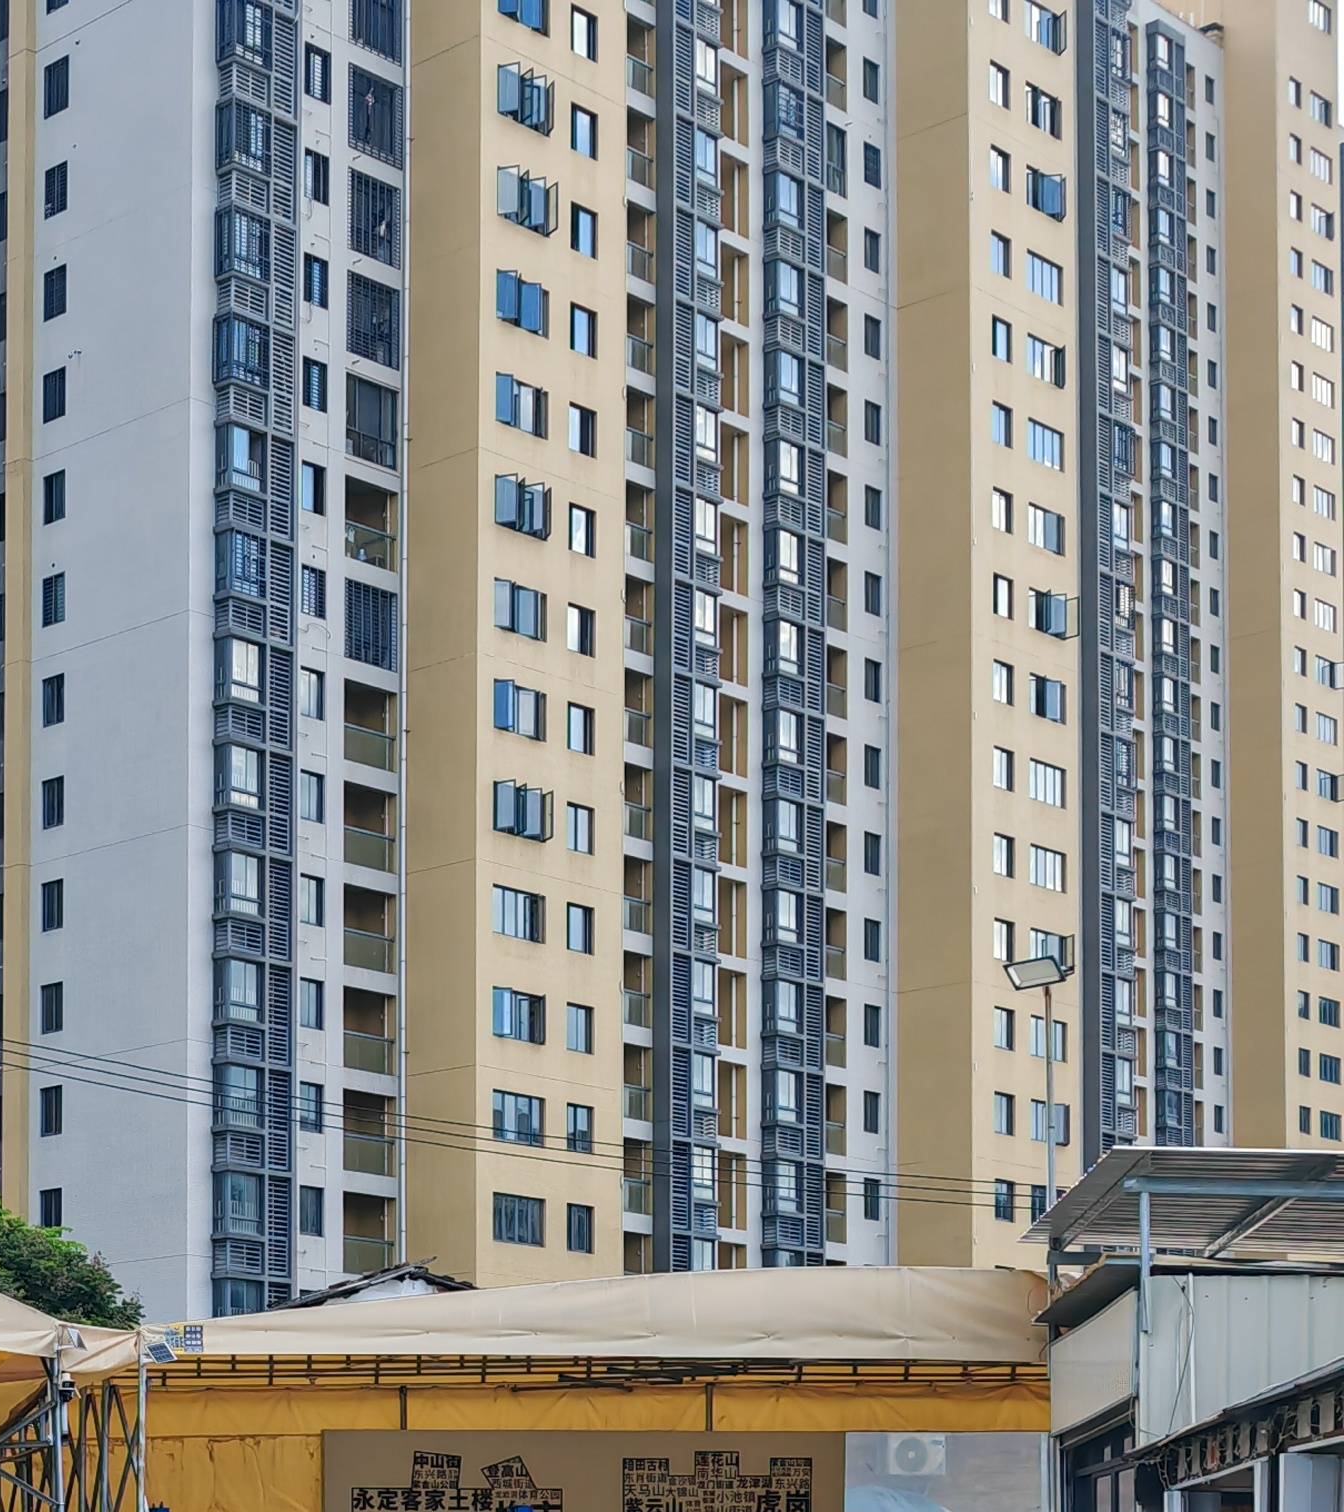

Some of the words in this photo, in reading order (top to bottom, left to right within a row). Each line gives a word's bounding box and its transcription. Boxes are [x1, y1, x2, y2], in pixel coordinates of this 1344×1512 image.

[353, 1488, 493, 1511] 永定客家土楼
